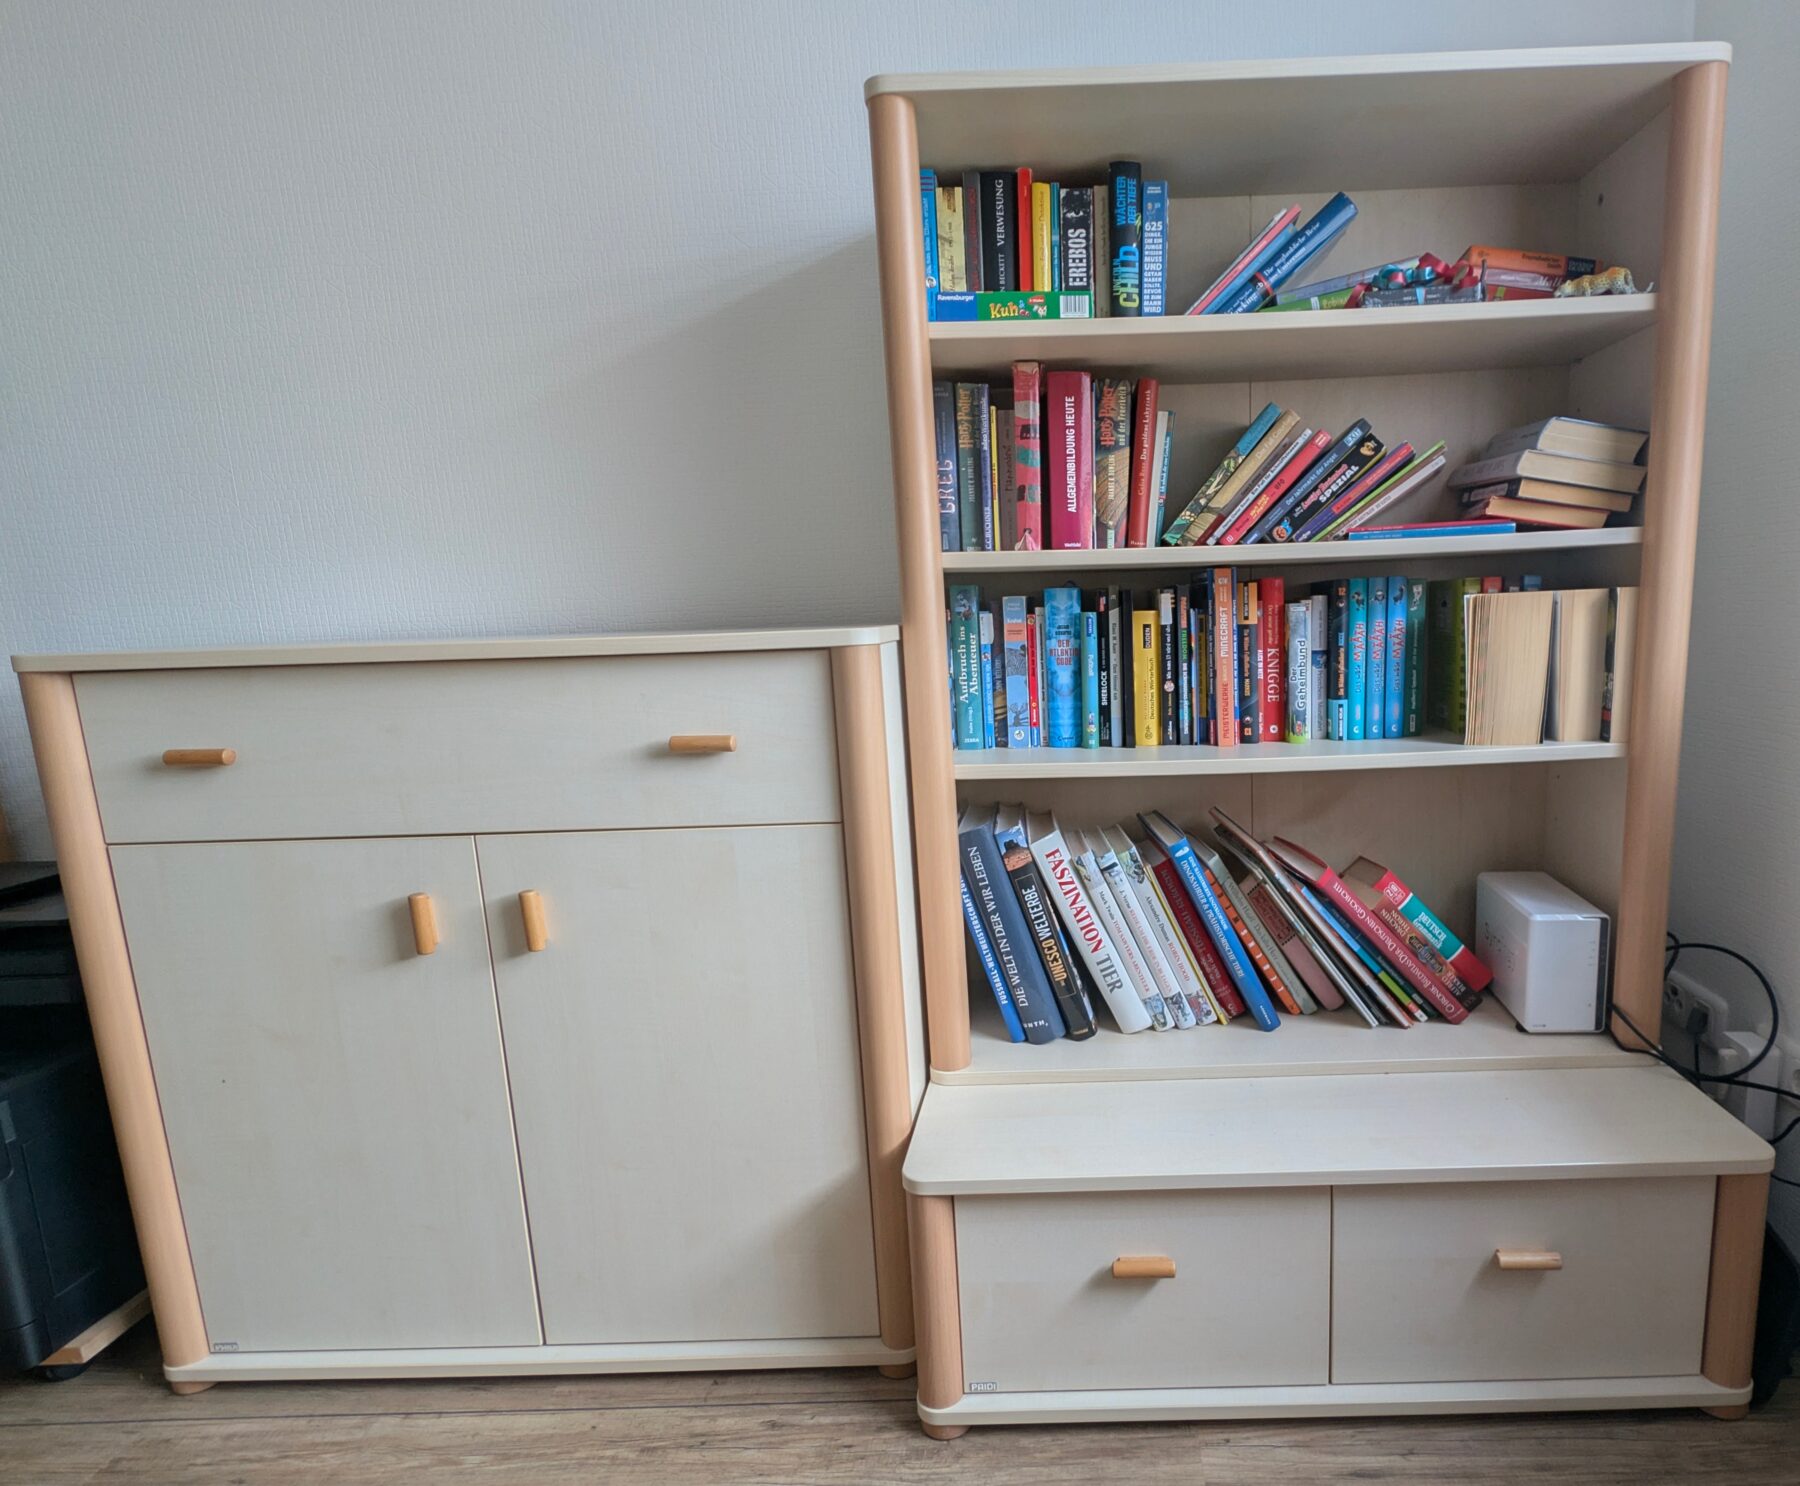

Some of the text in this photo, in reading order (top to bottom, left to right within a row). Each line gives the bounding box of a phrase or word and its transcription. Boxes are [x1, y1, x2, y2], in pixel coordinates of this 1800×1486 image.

[995, 179, 1005, 247] VERWESUNG
[1115, 176, 1126, 226] WÄCHTER
[1127, 178, 1136, 224] DER TIEFE
[1145, 222, 1162, 231] 625
[1068, 227, 1088, 286] EREBOS
[1120, 245, 1140, 308] CHILD
[1144, 263, 1162, 271] UND
[937, 294, 974, 302] Ravensburger
[989, 302, 1018, 318] Kuh
[955, 388, 974, 449] Harry Potter
[1098, 386, 1116, 446] Harry Potter
[1143, 390, 1153, 423] Labyrinth
[1065, 396, 1077, 513] ALLGEMEINBILDUNG HEUTE
[1118, 434, 1126, 446] und
[1250, 487, 1259, 496] Ein
[1274, 478, 1287, 491] UFO
[1285, 452, 1340, 506] Der Jahrmarkt der Angst
[1317, 463, 1361, 504] SPEZIAL
[1057, 639, 1070, 648] DER
[1219, 606, 1229, 657] MINECRAFT
[956, 626, 970, 704] Aufbruch ins
[967, 633, 980, 696] Abenteuer
[1266, 647, 1281, 702] KNIGGE
[1290, 667, 1298, 682] Der
[1296, 639, 1307, 710] Geheimbund
[1098, 890, 1109, 906] Mark
[1105, 905, 1116, 921] Twain
[1112, 920, 1122, 934] TOM
[1121, 894, 1133, 910] Verne
[1188, 856, 1230, 931] EINE ILLUSTRIERTE ENZYKLOPÄDIE
[967, 845, 1029, 1008] DIE WELT IN DER WIR LEBEN
[1021, 884, 1068, 982] UNESCO WELTERBE
[1044, 847, 1125, 995] FASZINATION TIER
[1144, 895, 1191, 983] Alexandre Dumas ROBIN HOOD
[1179, 860, 1208, 905] DINOSAURIER
[1204, 909, 1238, 962] PRÄHISTORISCHE
[1231, 961, 1245, 980] TIERE
[1379, 907, 1408, 937] DRACHEN
[1389, 909, 1412, 933] THRON
[1411, 917, 1445, 950] Grammatik
[1416, 911, 1448, 943] DEUTSCH
[963, 893, 1009, 1005] FUSSBALL-WELTMEISTERSCHAFT
[1440, 974, 1462, 996] ALFRED
[1445, 970, 1467, 992] BEKKER
[971, 1383, 996, 1391] PAIDI
